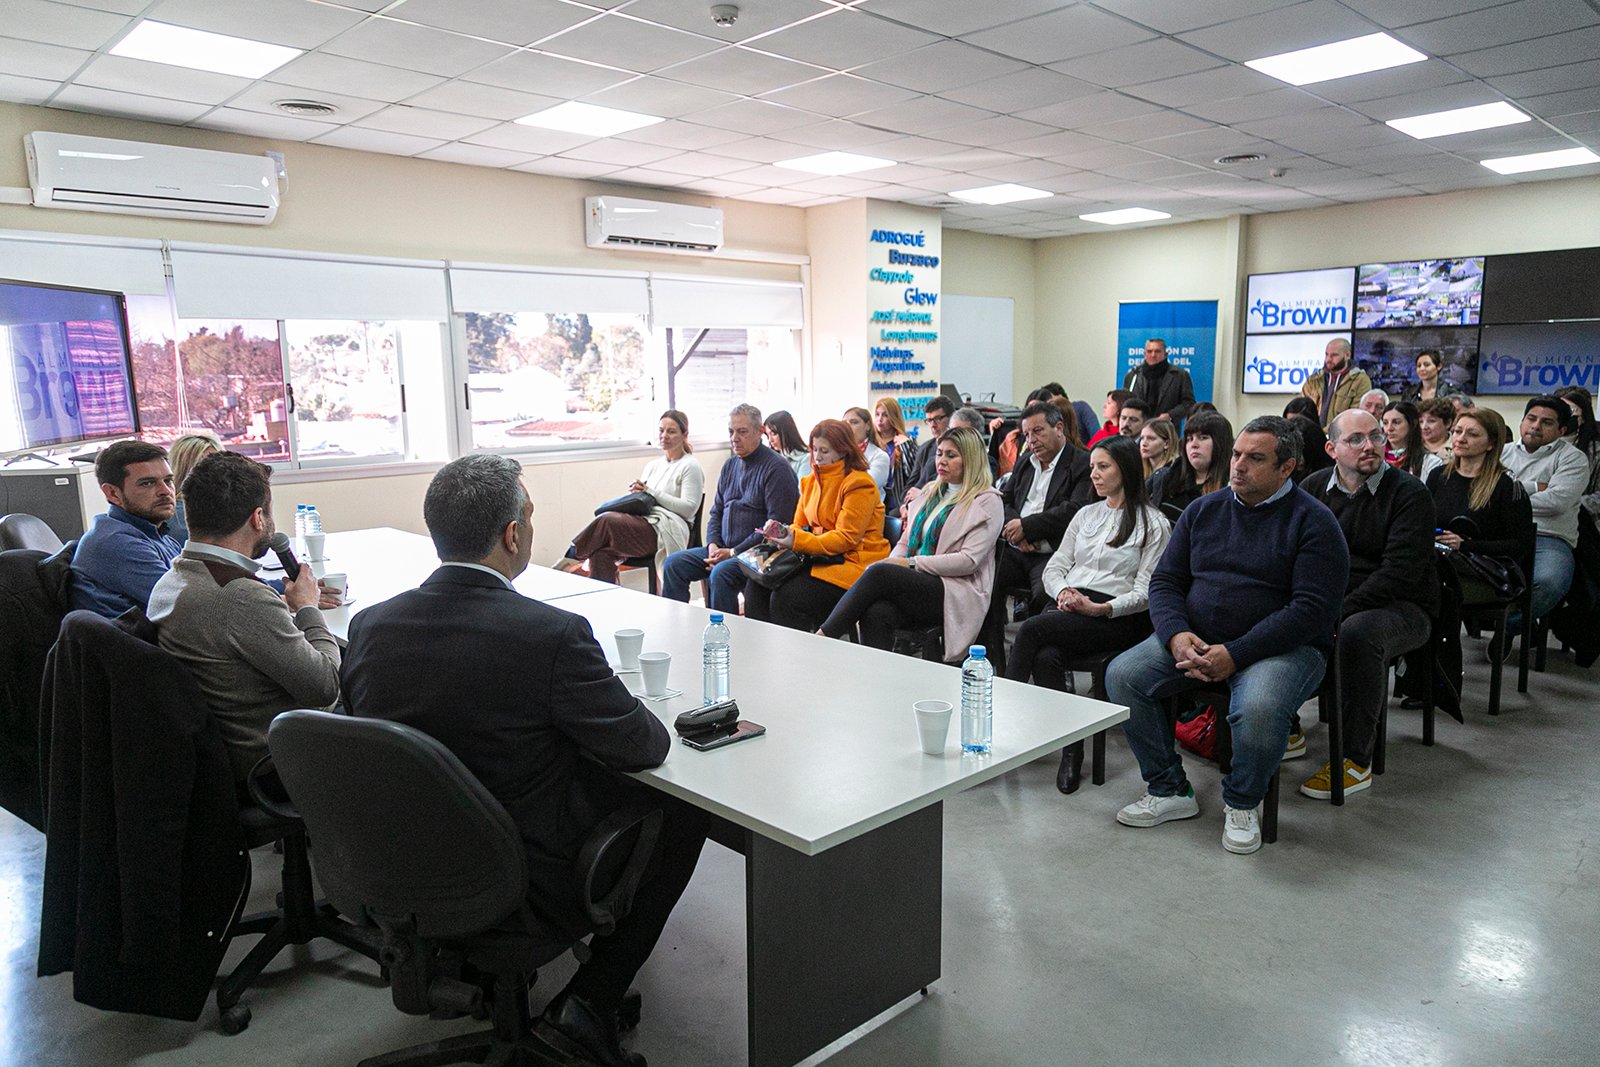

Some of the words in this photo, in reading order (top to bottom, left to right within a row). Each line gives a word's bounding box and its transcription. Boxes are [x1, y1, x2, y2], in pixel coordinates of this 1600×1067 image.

[870, 229, 925, 247] ADROGUÉ
[889, 249, 940, 268] Burzaco
[870, 268, 914, 284] Claypole
[904, 288, 938, 306] Glew
[1281, 297, 1346, 307] ALMIRANTE
[1262, 303, 1347, 327] Brown
[1181, 347, 1195, 356] DE
[1173, 357, 1192, 366] DEL
[1278, 358, 1321, 367] ALMIRA
[1524, 355, 1595, 364] ALMIRAN
